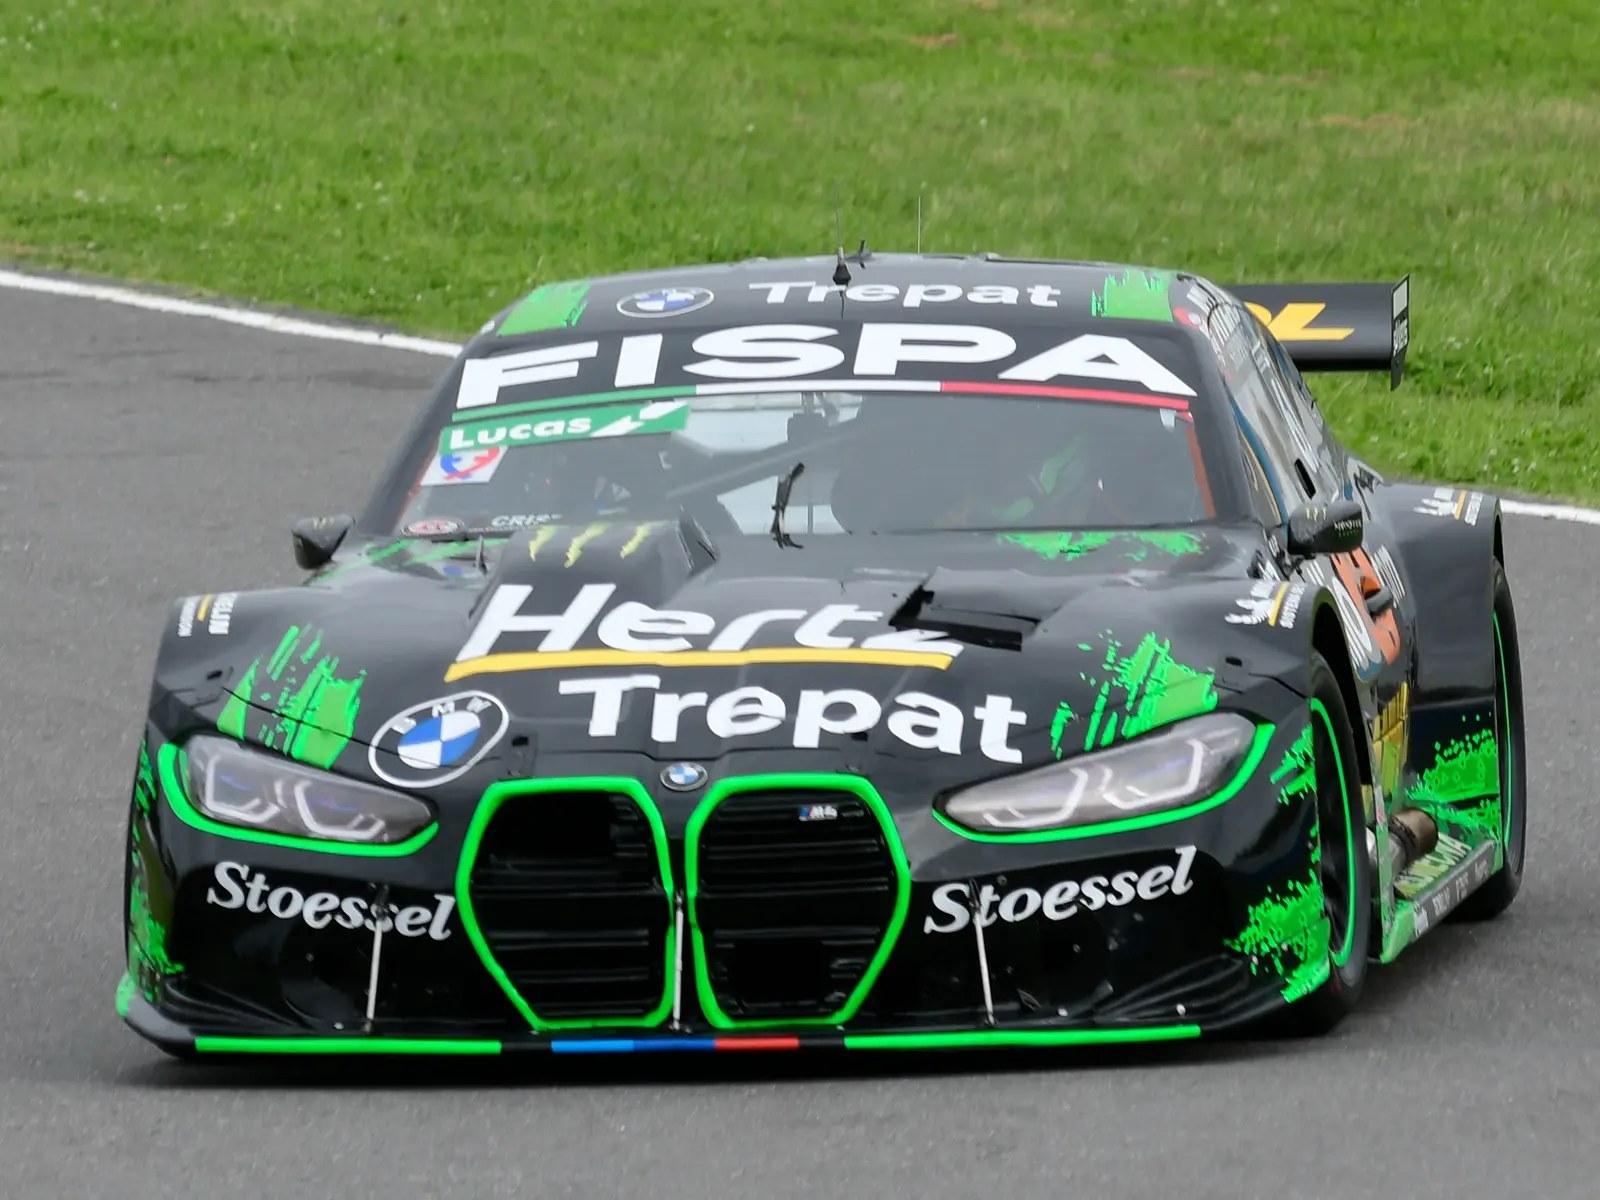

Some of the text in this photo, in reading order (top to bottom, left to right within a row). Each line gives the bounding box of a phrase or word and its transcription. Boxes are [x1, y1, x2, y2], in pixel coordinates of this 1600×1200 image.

[749, 281, 1061, 307] Trepat
[456, 323, 1198, 409] FISPA
[450, 415, 591, 450] Lucas
[455, 583, 963, 663] Hertz
[558, 674, 1026, 764] Trepat
[207, 861, 456, 940] Stoessel
[924, 845, 1198, 935] Stoessel
